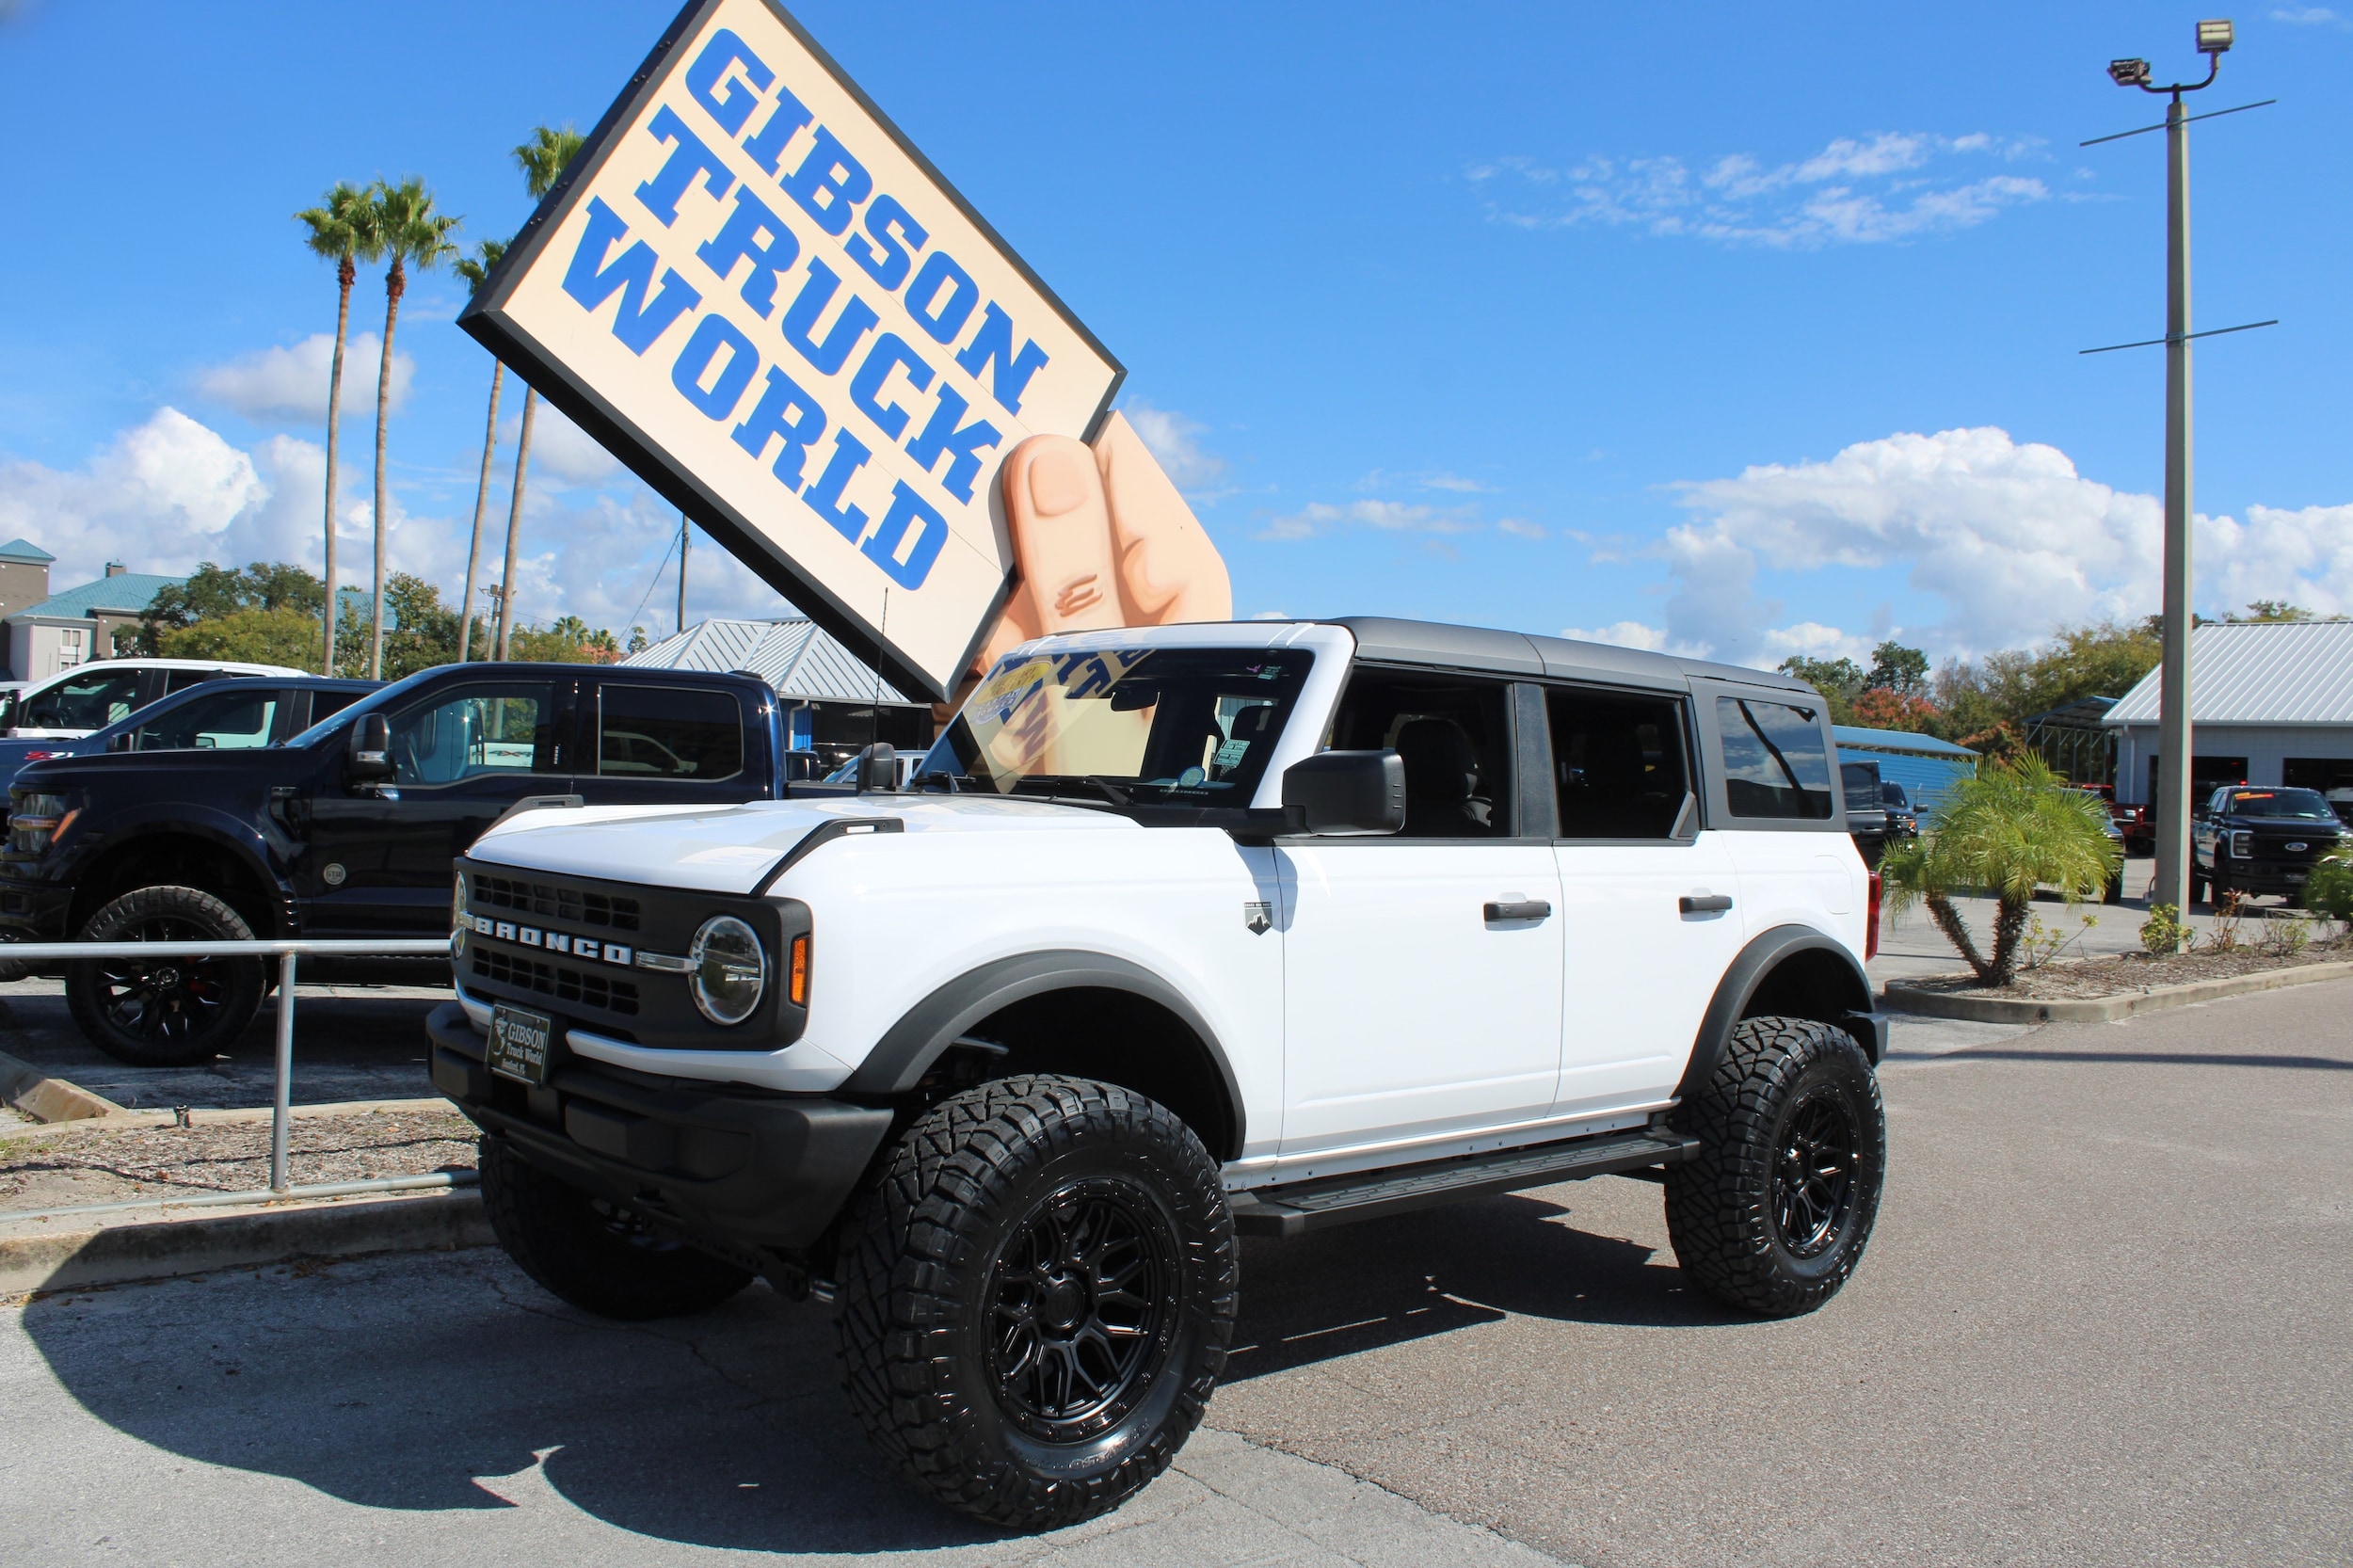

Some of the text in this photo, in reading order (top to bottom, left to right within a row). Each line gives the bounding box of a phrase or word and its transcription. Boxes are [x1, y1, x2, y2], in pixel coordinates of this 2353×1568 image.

[685, 28, 1049, 416] GIBSON
[633, 104, 1002, 505] TRUCK
[561, 195, 949, 591] WORLD
[24, 751, 74, 760] Z71
[474, 916, 632, 966] BRONCO
[506, 1042, 543, 1065] Truck World
[508, 1022, 546, 1050] GIBSON
